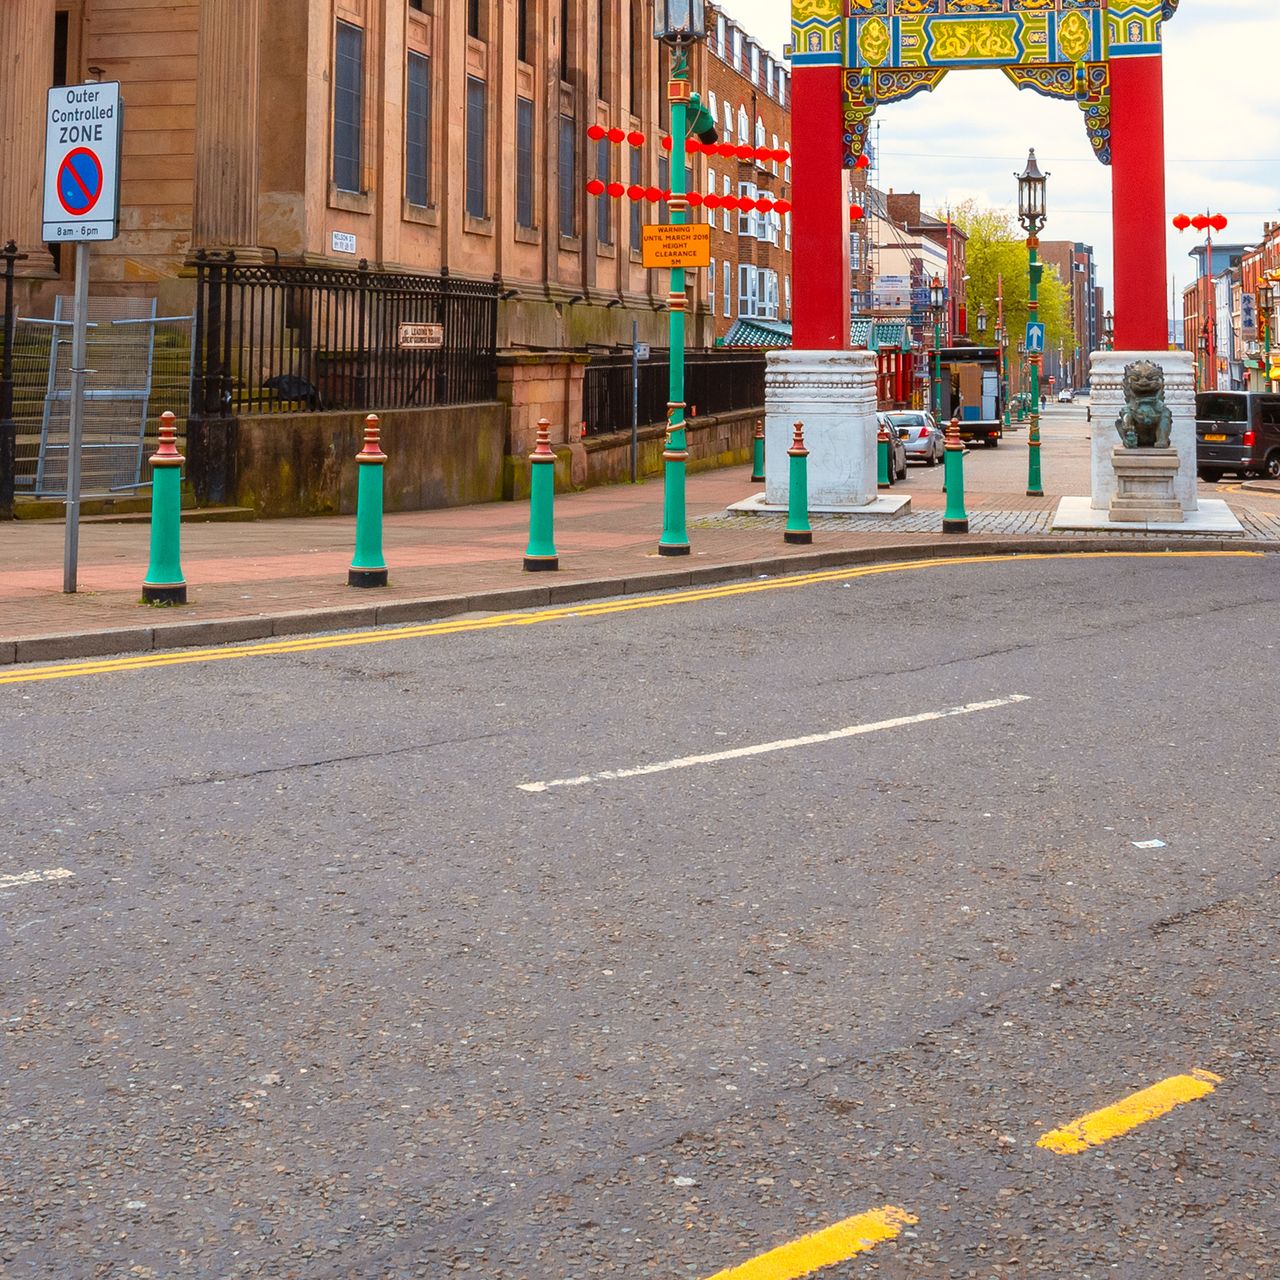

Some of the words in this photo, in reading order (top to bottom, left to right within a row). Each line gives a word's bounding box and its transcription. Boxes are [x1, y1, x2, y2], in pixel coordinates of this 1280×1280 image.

[66, 90, 100, 104] Outer
[51, 105, 114, 123] Controlled
[59, 124, 103, 143] ZONE
